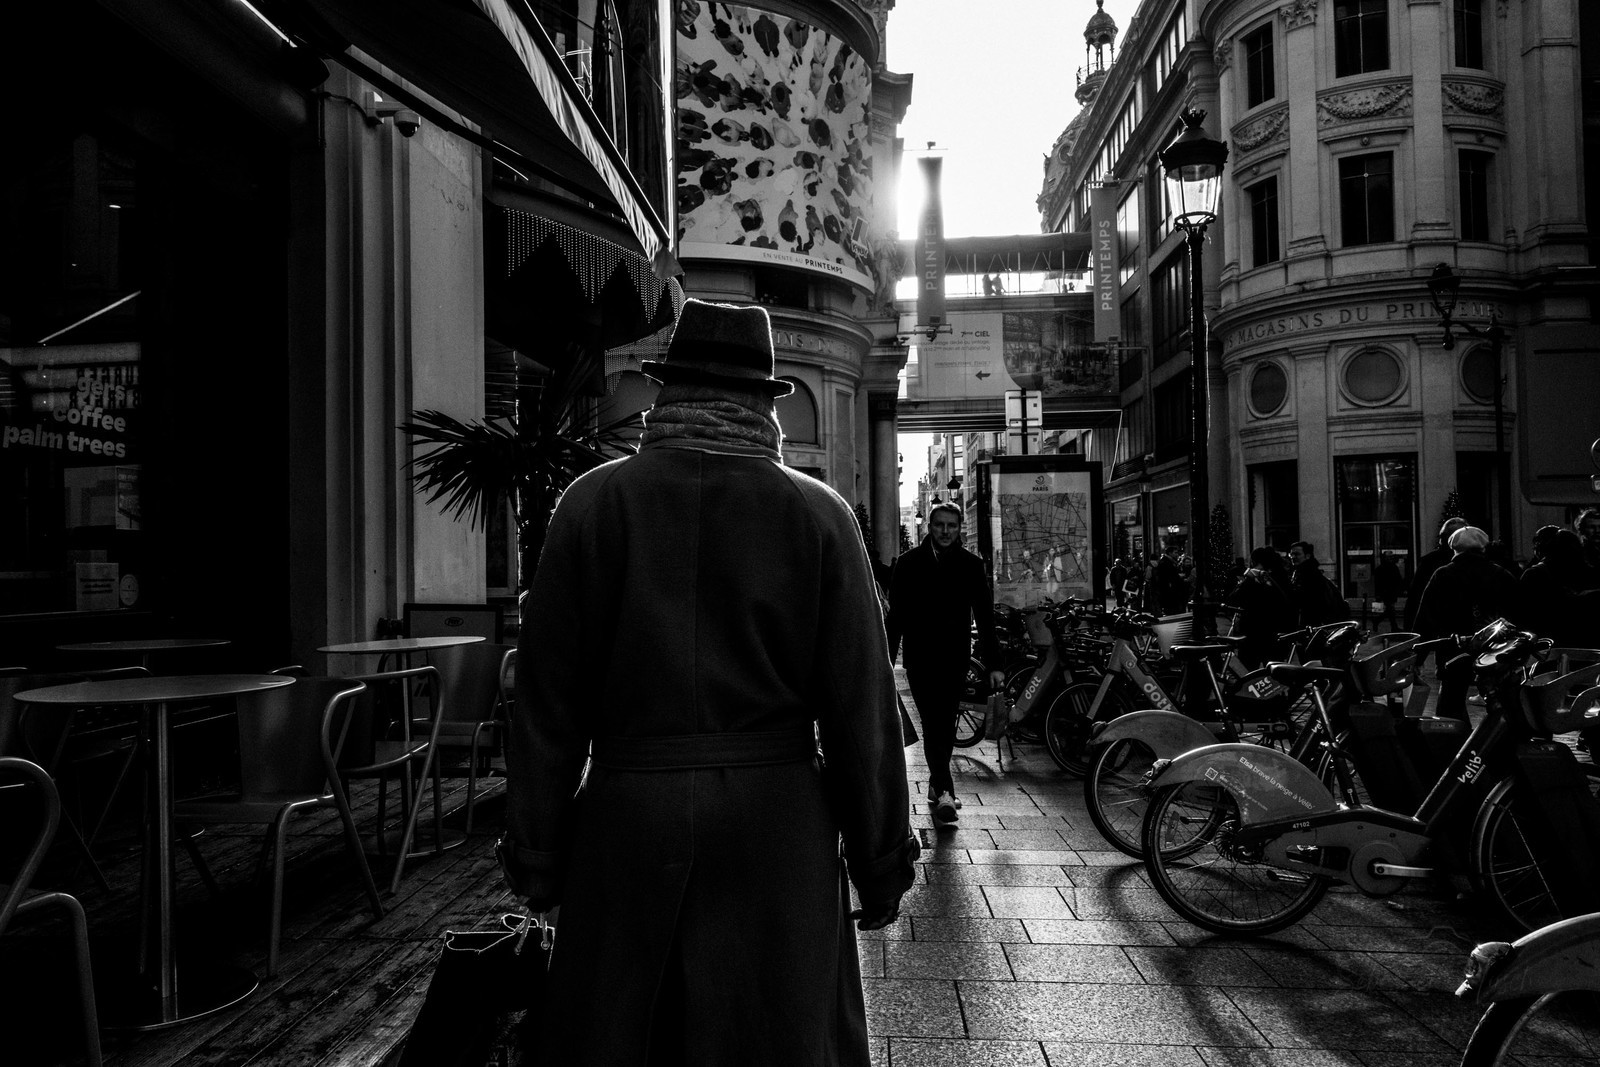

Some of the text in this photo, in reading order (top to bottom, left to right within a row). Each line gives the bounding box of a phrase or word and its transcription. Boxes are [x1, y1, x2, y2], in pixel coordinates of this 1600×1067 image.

[804, 258, 843, 274] PRINTEMPS
[1100, 220, 1113, 311] PRINTEMPS
[974, 330, 990, 338] CIEL
[1237, 312, 1324, 346] MAGASINS
[1339, 306, 1369, 324] DU
[1386, 301, 1505, 319] PRINEMPS
[52, 405, 126, 432] coffee
[2, 423, 126, 458] palm trees
[1025, 676, 1042, 700] dott
[1239, 756, 1254, 770] Elsa
[1252, 765, 1271, 781] brave
[1269, 777, 1277, 785] la
[1274, 781, 1294, 798] neige
[1292, 820, 1311, 829] 47102
